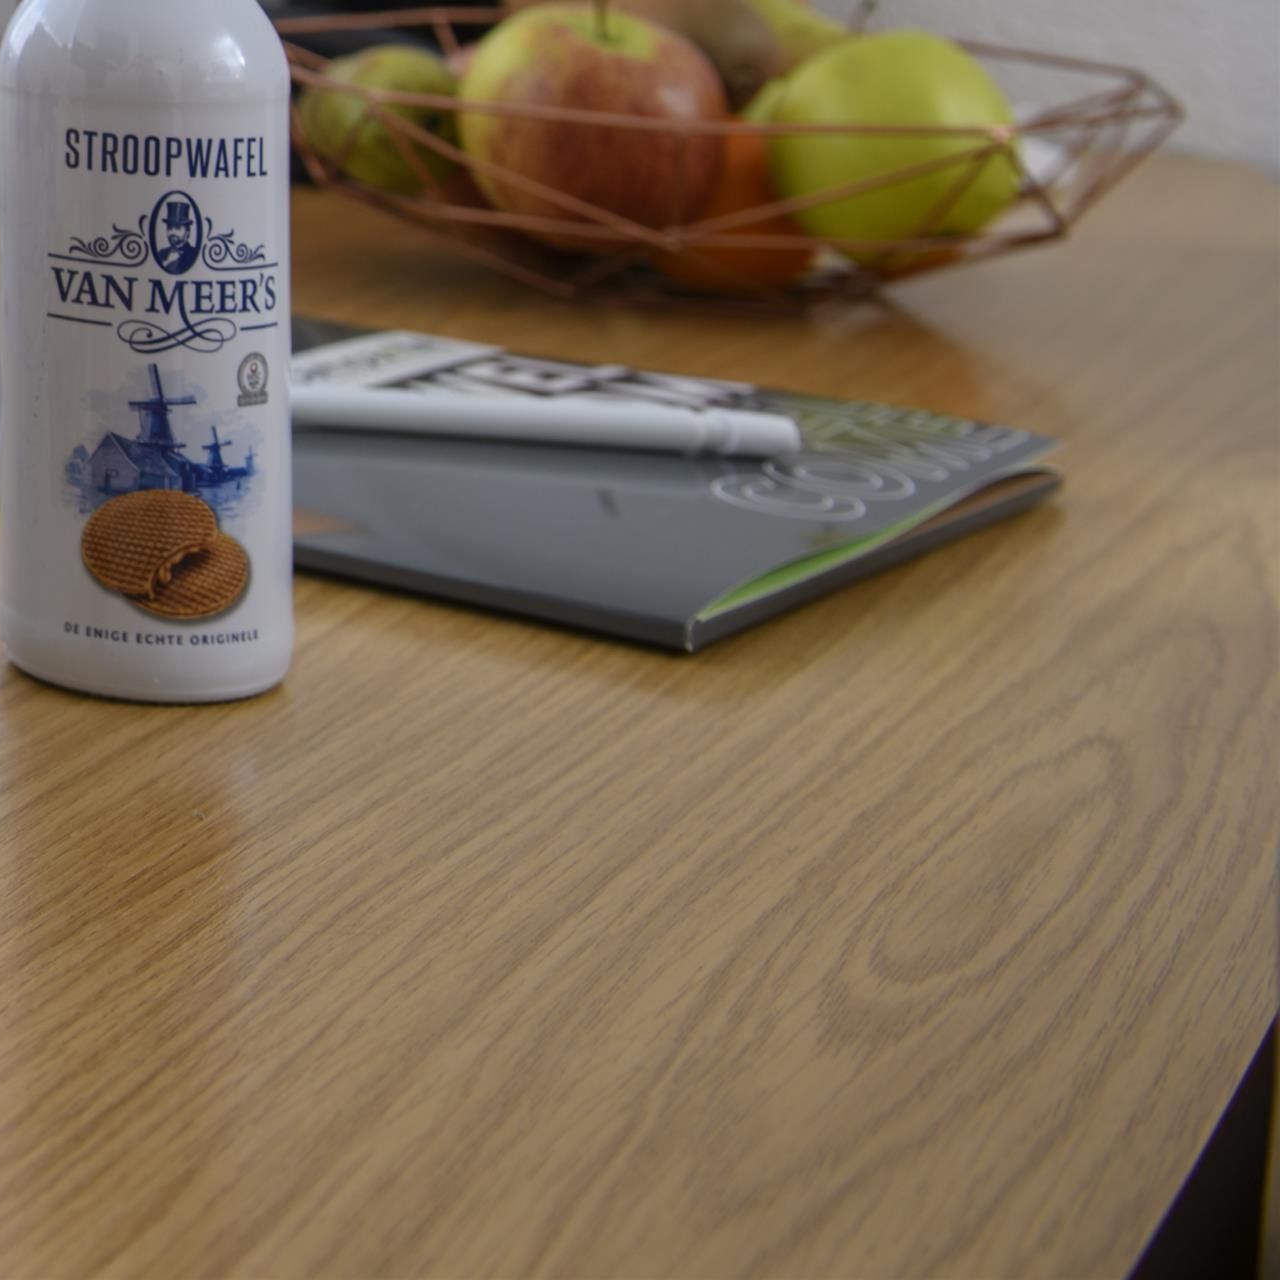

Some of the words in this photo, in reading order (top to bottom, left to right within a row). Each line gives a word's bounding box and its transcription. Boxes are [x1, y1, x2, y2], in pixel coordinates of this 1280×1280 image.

[65, 128, 268, 179] STROOPWAFEL
[51, 267, 138, 312] VAN
[145, 272, 276, 315] MEER'S
[64, 622, 79, 634] DE
[86, 626, 128, 643] ENIGE
[136, 633, 183, 646] ECHTE
[190, 628, 259, 646] ORIGINELE
